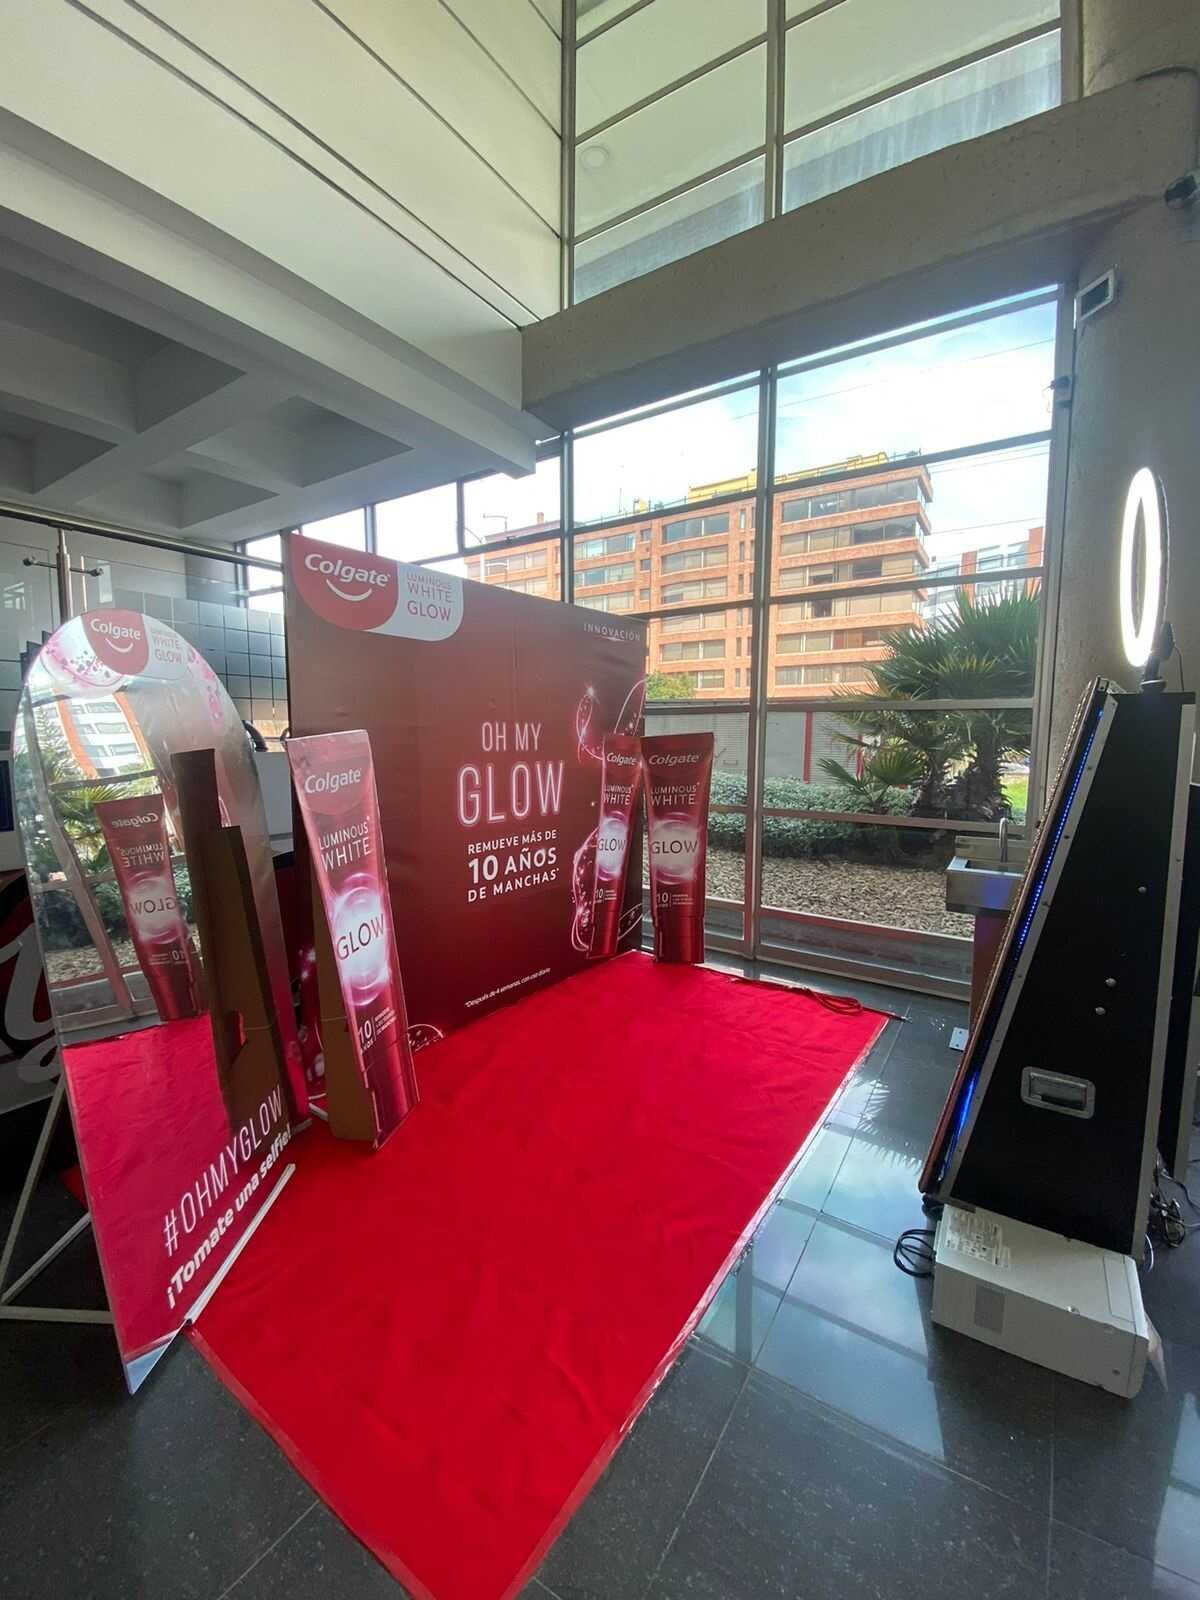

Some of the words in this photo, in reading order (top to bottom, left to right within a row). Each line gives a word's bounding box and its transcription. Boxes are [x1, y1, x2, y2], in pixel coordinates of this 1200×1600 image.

[304, 553, 390, 588] Colgate
[407, 572, 452, 590] LUMINO
[407, 581, 453, 603] WHITE
[407, 600, 451, 621] GLOW
[91, 618, 141, 640] Colgate
[482, 722, 506, 752] OH
[515, 723, 541, 752] MY
[607, 752, 637, 766] Colgate
[649, 754, 699, 766] Colgate
[305, 768, 361, 793] Colgate
[603, 784, 632, 794] LUMINOUS
[651, 784, 697, 794] LUMINOUS
[459, 761, 564, 826] GLOW
[603, 793, 632, 806] WHITE
[651, 793, 696, 806] WHITE
[318, 821, 369, 850] LUMINOUS
[468, 836, 519, 855] REMUEVE
[522, 830, 542, 844] MÁS
[545, 829, 557, 841] DE
[599, 838, 626, 852] GLOW
[321, 837, 371, 872] WHITE
[652, 840, 698, 854] GLOW
[469, 855, 498, 884] 10
[504, 847, 557, 875] AÑOS
[468, 887, 487, 902] DE
[337, 913, 385, 961] GLOW
[164, 1084, 283, 1256] #OHMYGLOW
[166, 1208, 234, 1309] ¡Tomate
[235, 1173, 260, 1213] una
[260, 1123, 292, 1179] selfie!
